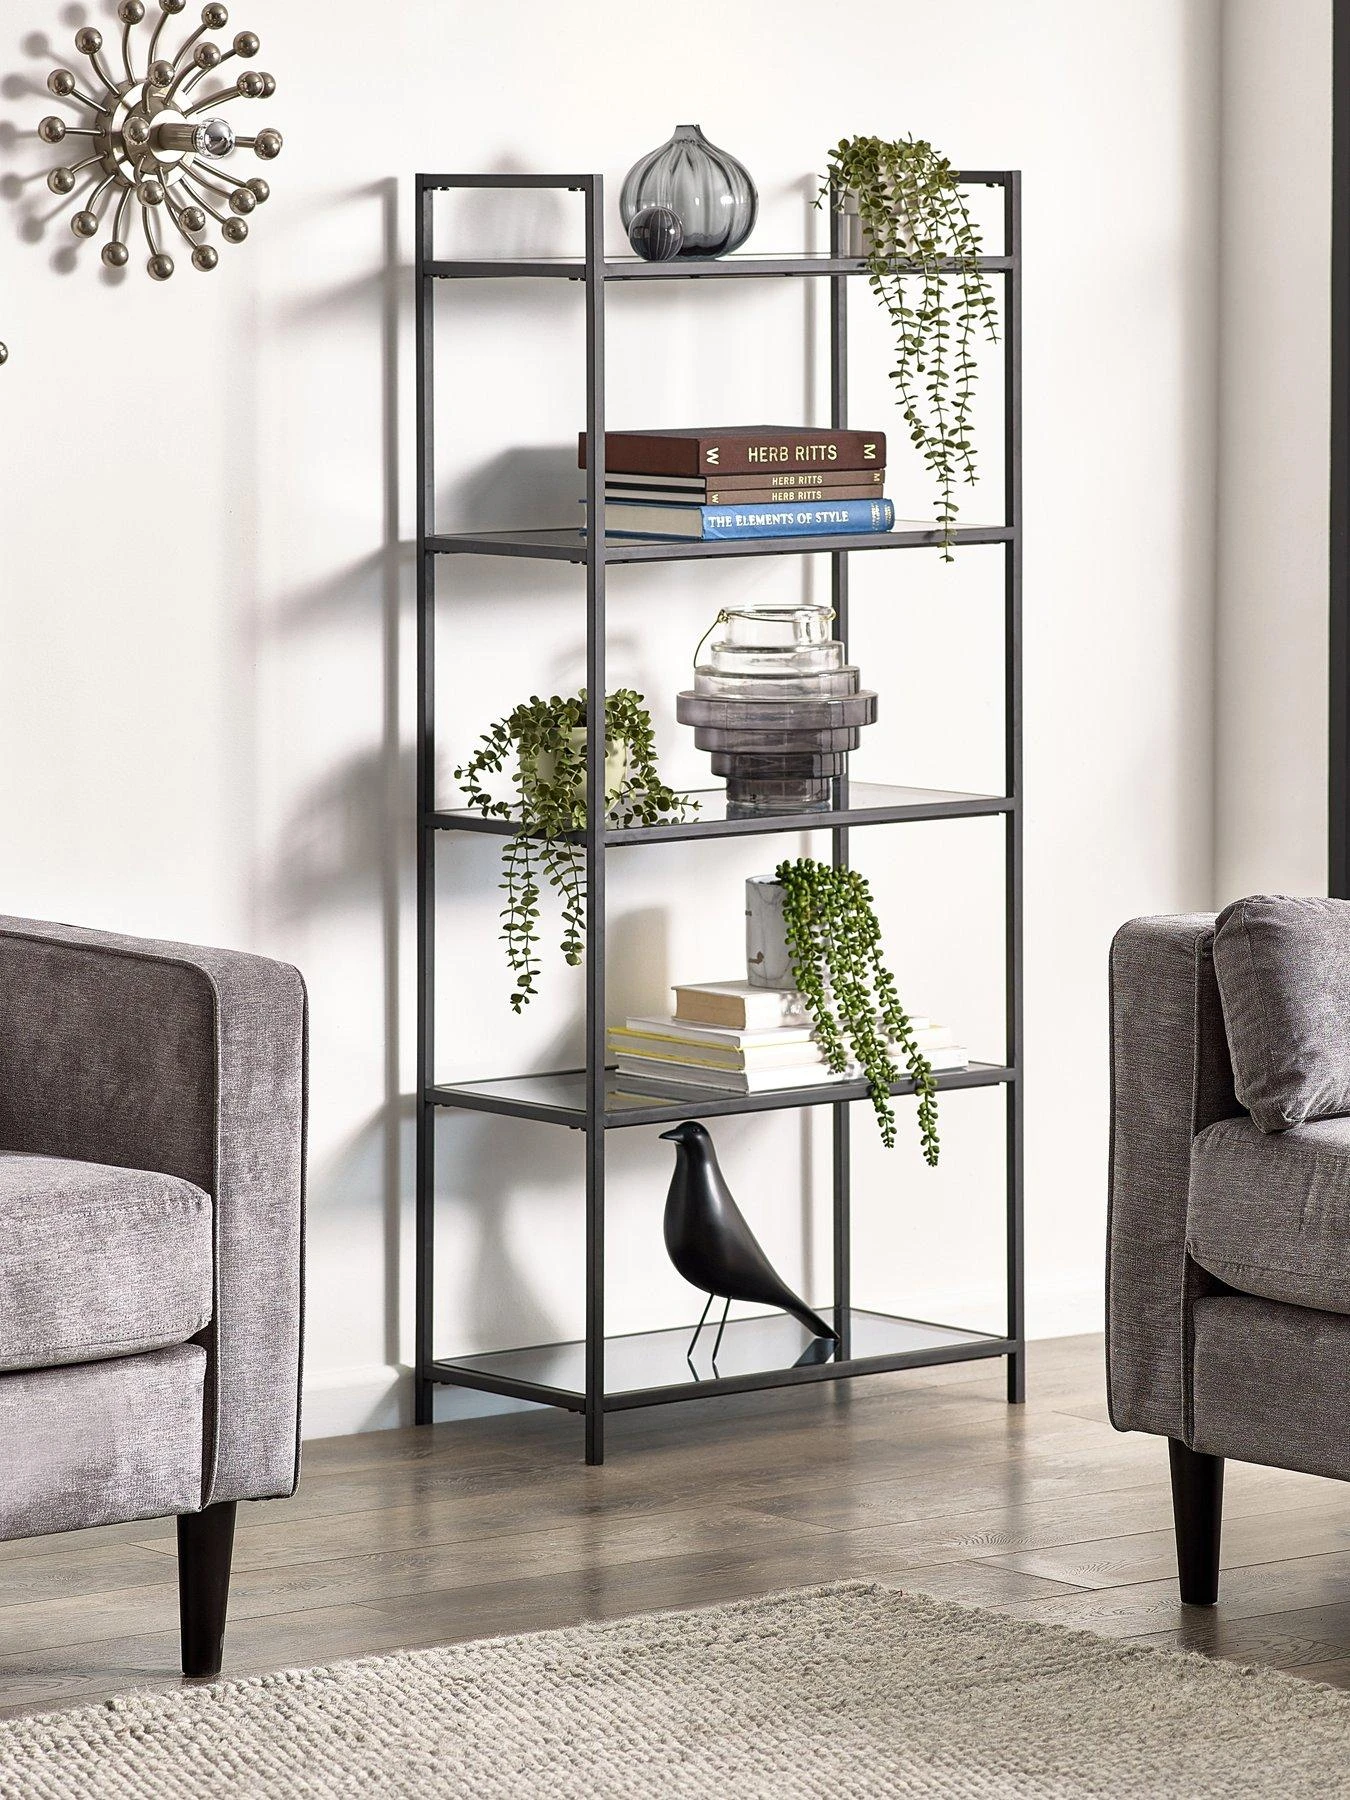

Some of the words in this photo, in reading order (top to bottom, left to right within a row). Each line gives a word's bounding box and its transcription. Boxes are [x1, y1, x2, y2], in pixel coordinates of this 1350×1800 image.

[748, 446, 789, 463] HERB
[795, 444, 838, 461] RITTS
[863, 443, 877, 460] M
[772, 476, 796, 486] HERB
[798, 475, 823, 485] RITTS
[771, 492, 795, 501] HERB
[797, 490, 822, 500] RITTS
[708, 516, 733, 528] THE
[735, 513, 794, 526] ELEMENTS
[796, 512, 813, 525] OF
[815, 510, 849, 522] STYLE
